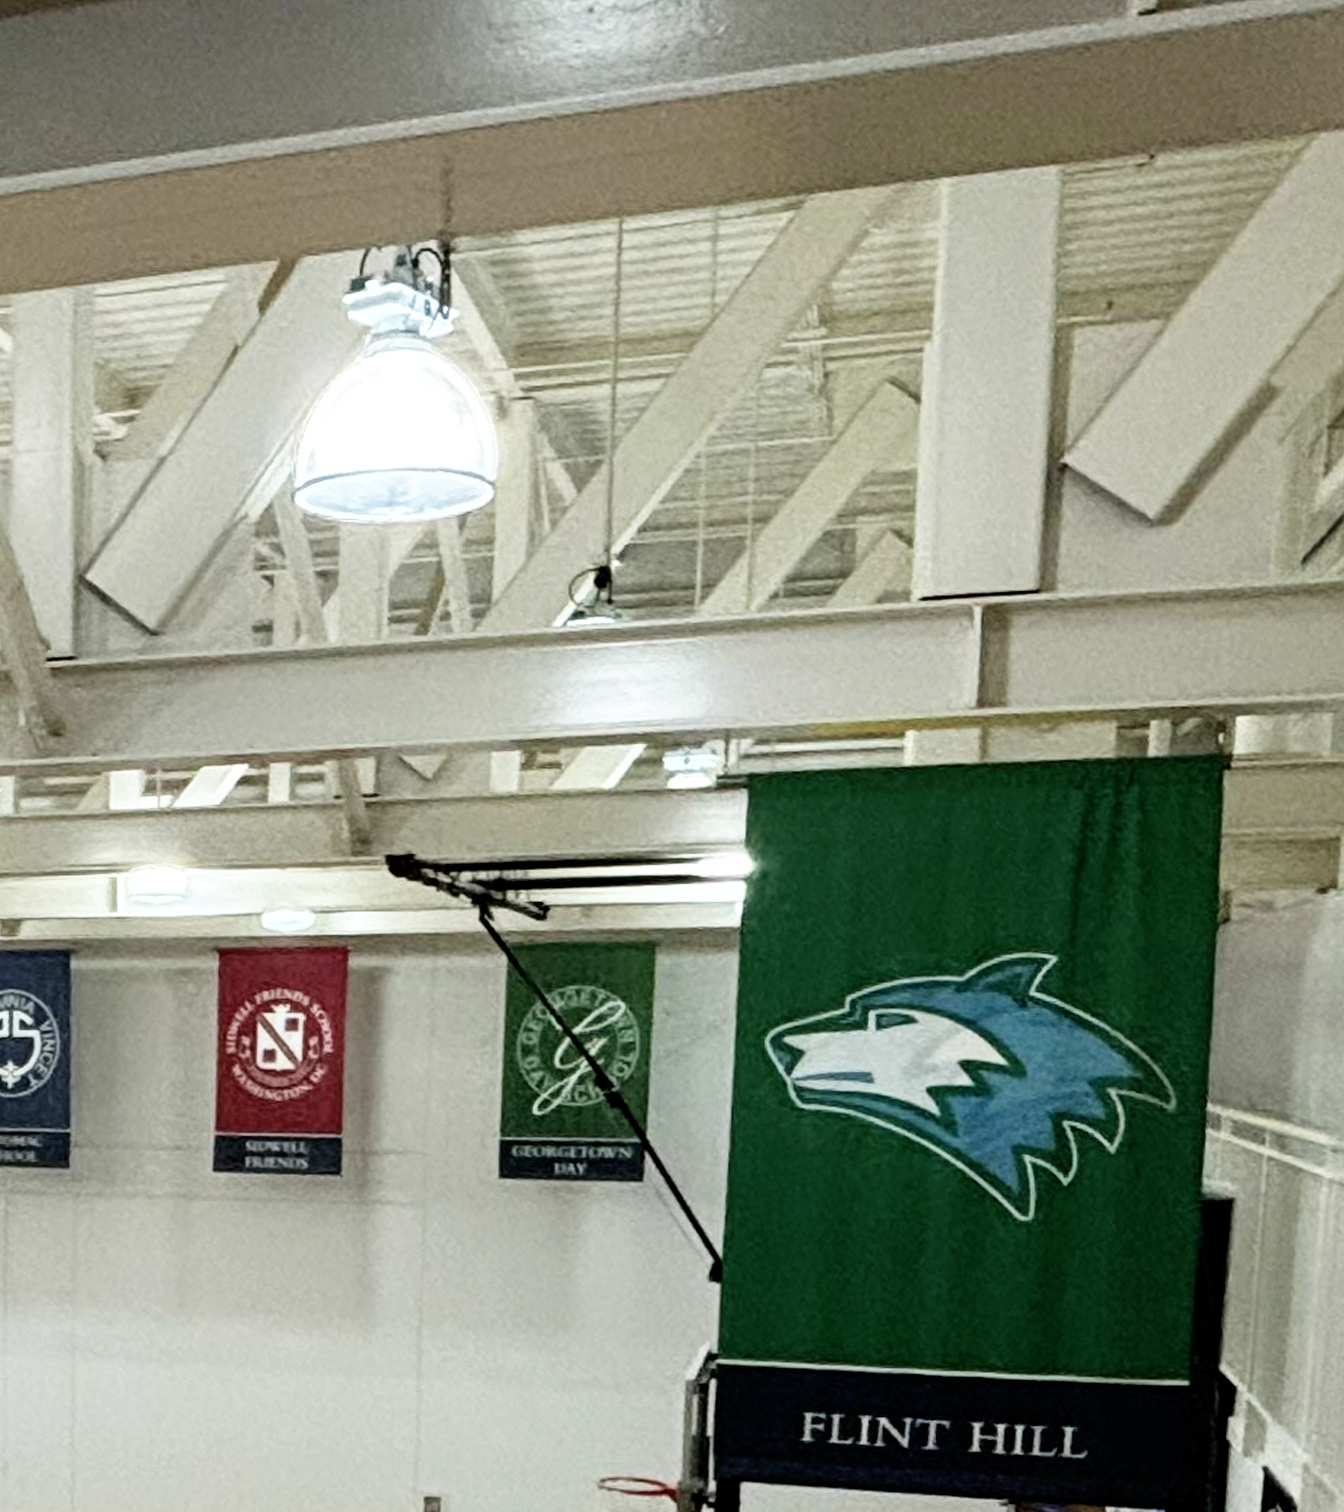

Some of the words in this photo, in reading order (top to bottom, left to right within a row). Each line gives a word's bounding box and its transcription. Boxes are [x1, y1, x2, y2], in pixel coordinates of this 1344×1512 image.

[254, 988, 311, 1006] FRIENDS
[244, 1140, 308, 1154] SIDWELL
[512, 1145, 632, 1159] GEORGETOWN
[244, 1156, 310, 1170] FRIENDS
[554, 1162, 587, 1176] DAY
[800, 1411, 951, 1451] FLINT
[967, 1420, 1089, 1460] HILL
